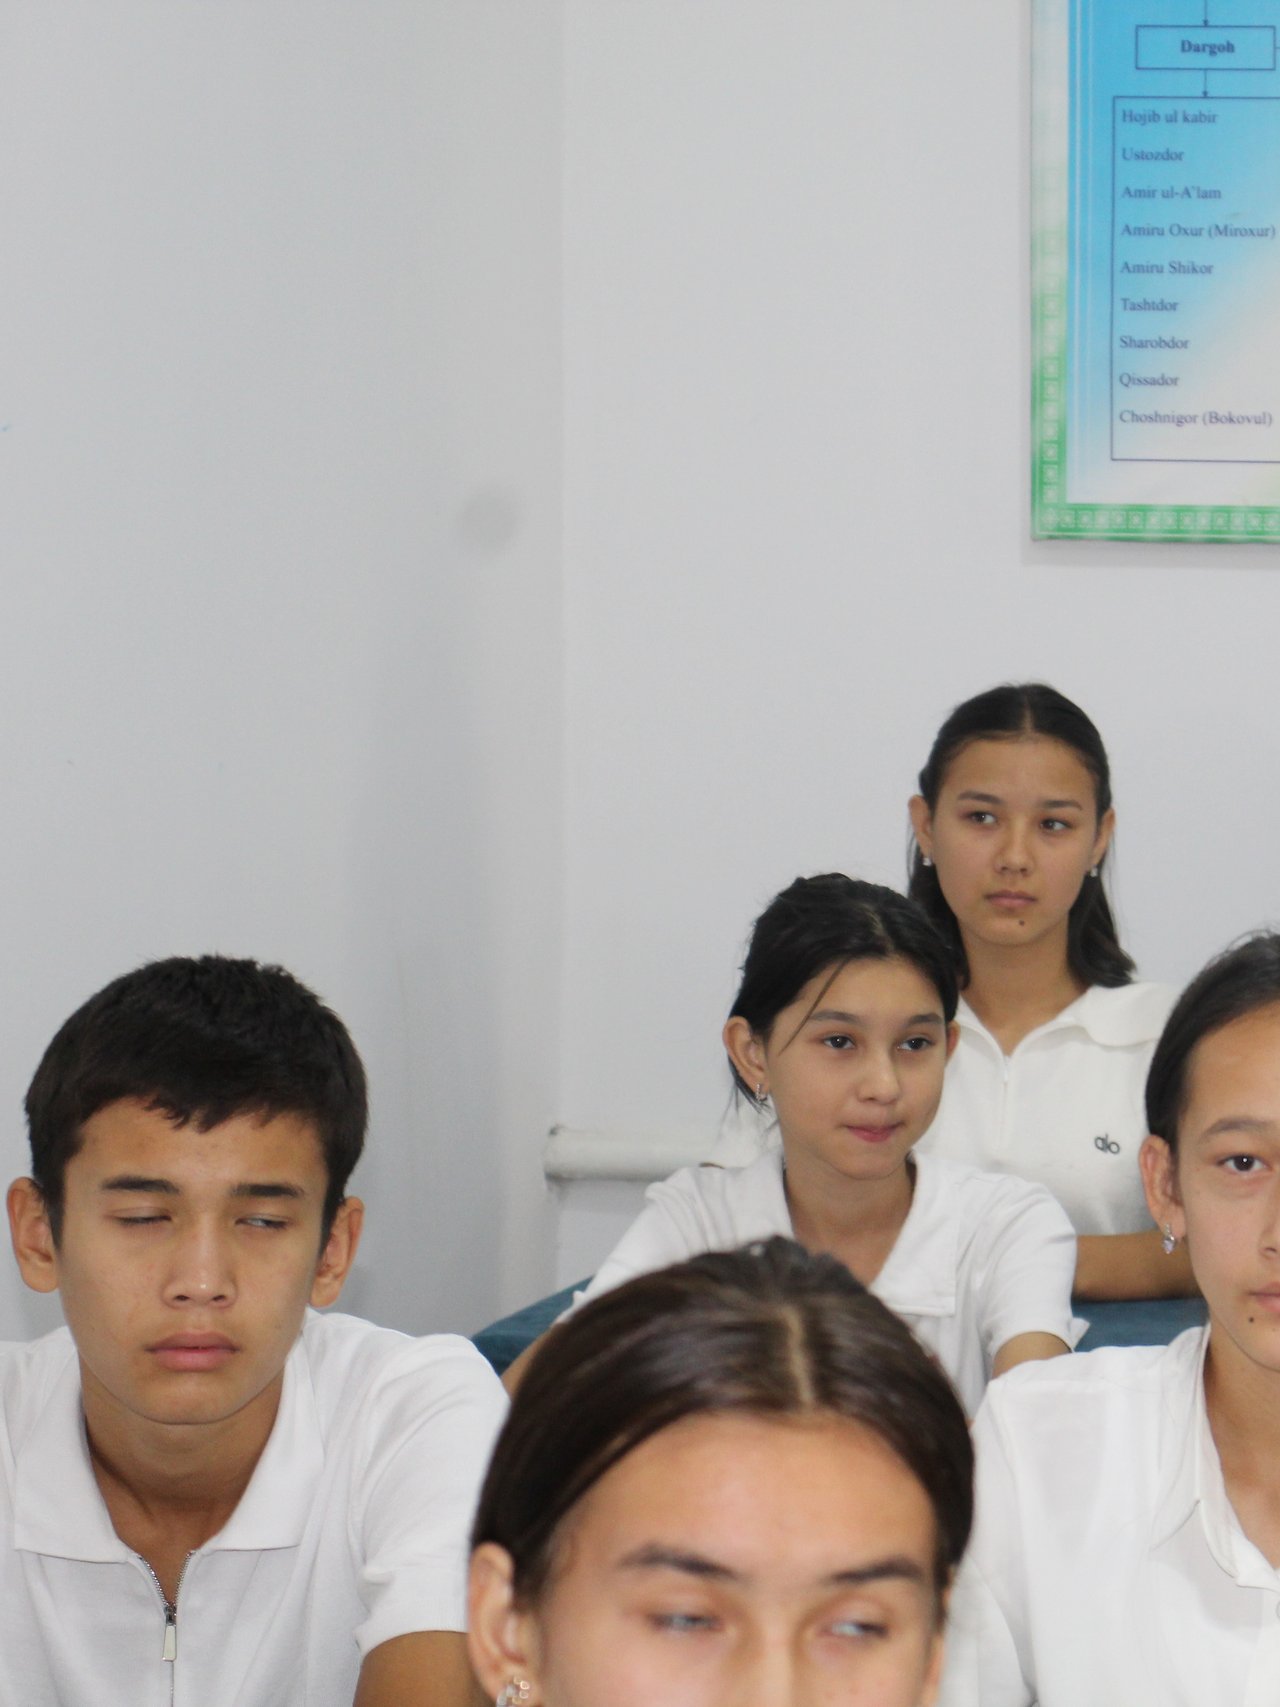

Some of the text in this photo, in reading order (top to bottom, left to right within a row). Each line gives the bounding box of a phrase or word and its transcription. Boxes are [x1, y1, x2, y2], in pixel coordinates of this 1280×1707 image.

[1181, 39, 1235, 56] Dargoh
[1122, 110, 1217, 125] Hojib ul kabir
[1122, 148, 1185, 161] Ustozdor
[1122, 186, 1157, 199] Amir
[1122, 223, 1276, 240] Amiru Oxur (Miroxur)
[1120, 261, 1213, 274] Amiru Shikor
[1121, 298, 1178, 311] Tashtdor
[1119, 336, 1190, 349] Sharobdor
[1119, 373, 1180, 388] Qissador
[1119, 410, 1273, 427] Choshnigor (Bokovul)
